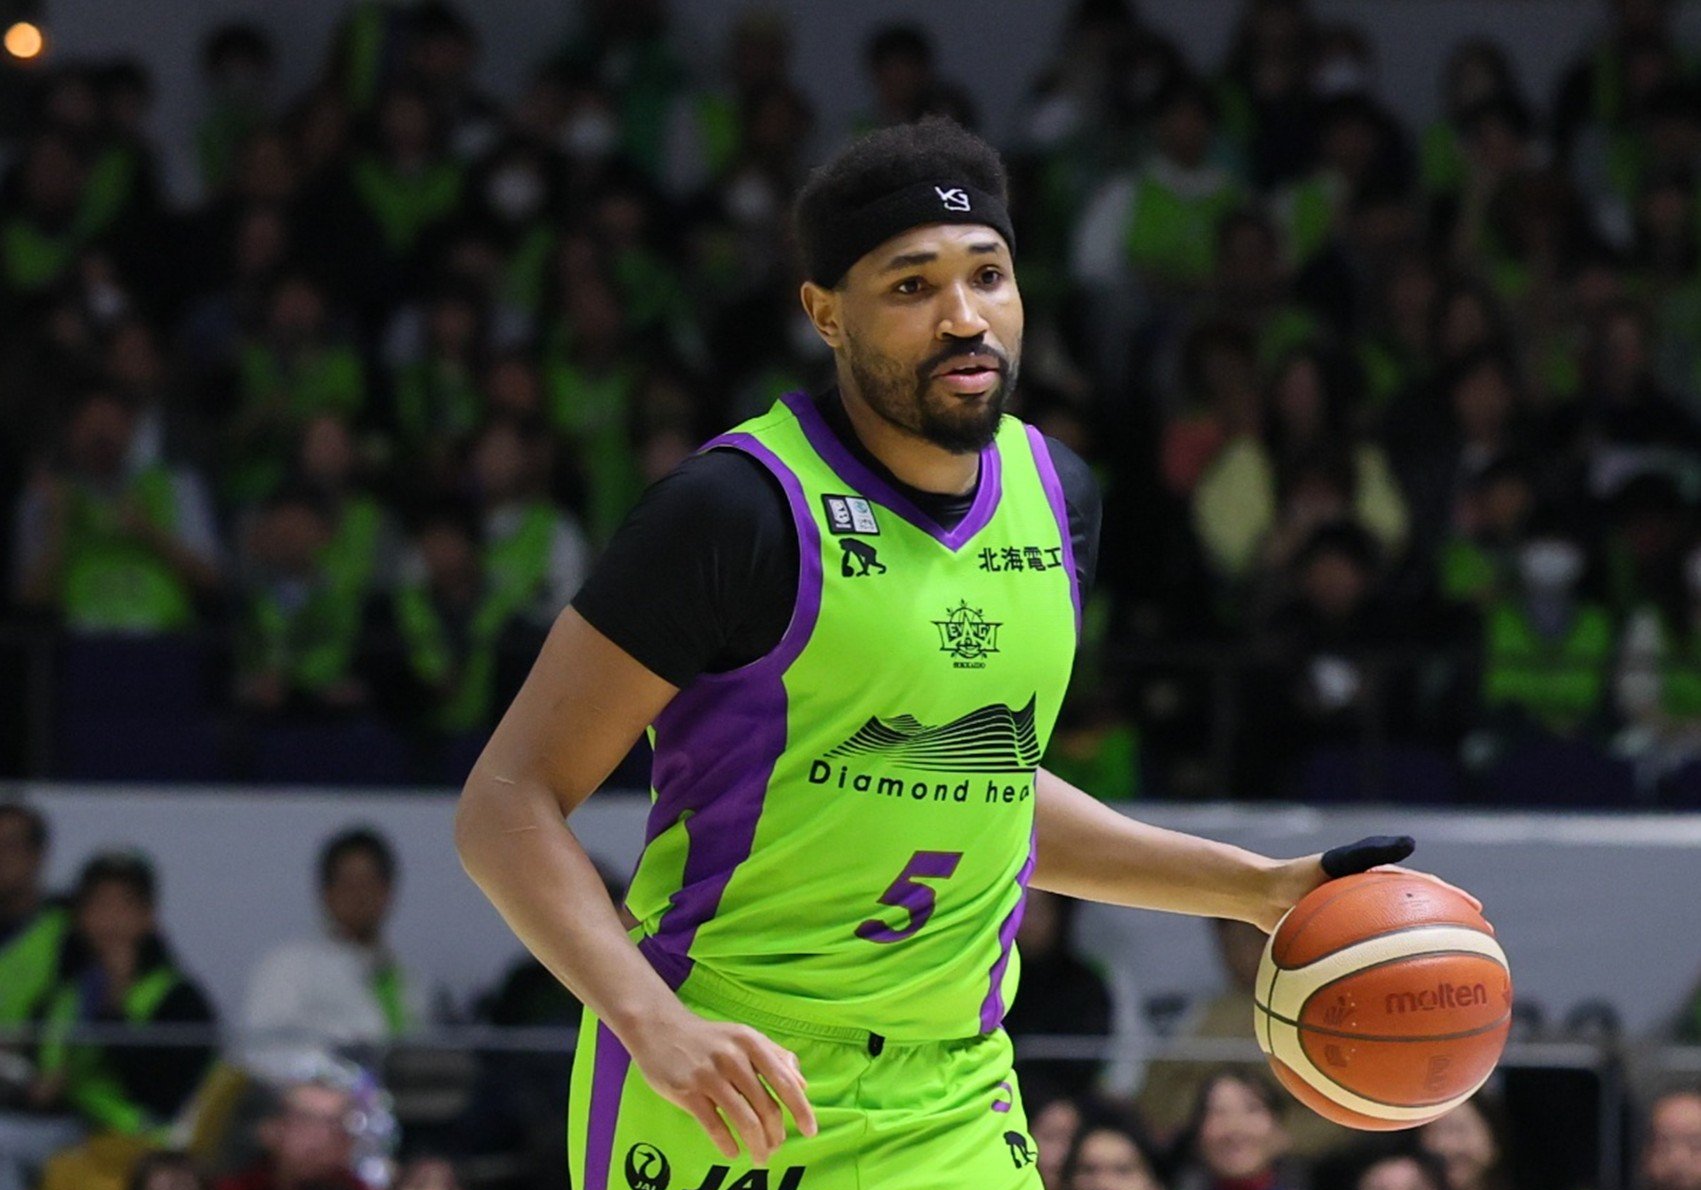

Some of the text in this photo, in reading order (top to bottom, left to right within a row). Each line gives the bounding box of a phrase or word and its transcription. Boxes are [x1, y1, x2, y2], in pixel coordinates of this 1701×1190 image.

[978, 546, 1062, 572] 北海電工
[808, 759, 969, 802] Diamond
[854, 850, 964, 944] 5
[1385, 982, 1487, 1015] molten
